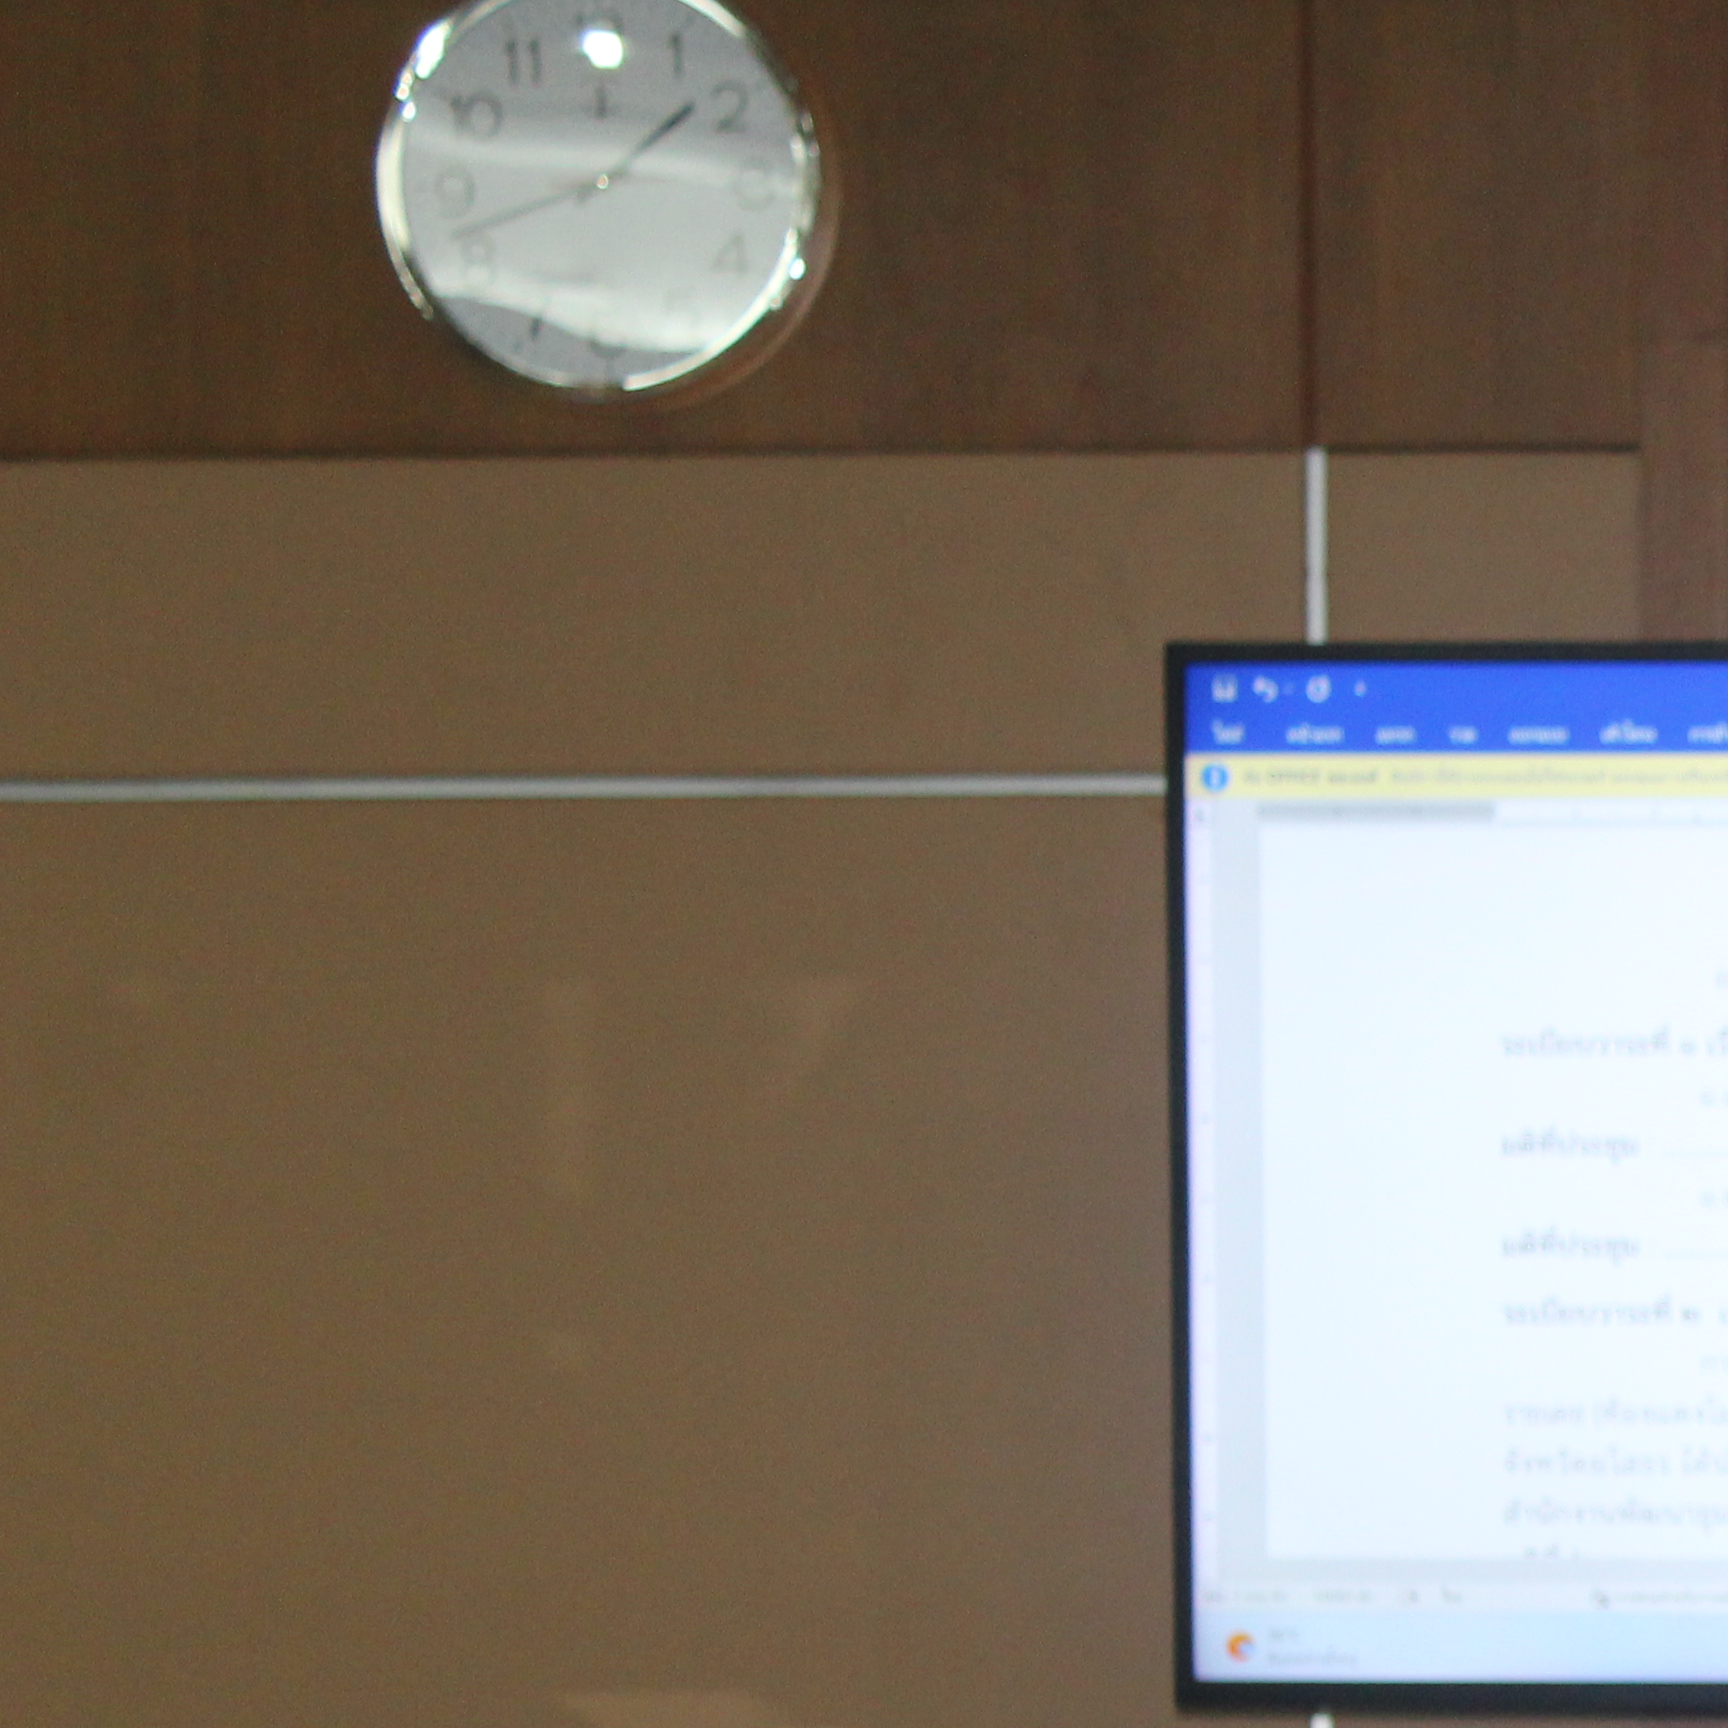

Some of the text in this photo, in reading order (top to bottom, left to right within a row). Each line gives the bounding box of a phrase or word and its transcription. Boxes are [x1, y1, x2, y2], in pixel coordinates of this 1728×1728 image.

[505, 35, 543, 86] 11
[667, 31, 683, 78] 1
[450, 91, 504, 143] 10
[711, 79, 749, 135] 2
